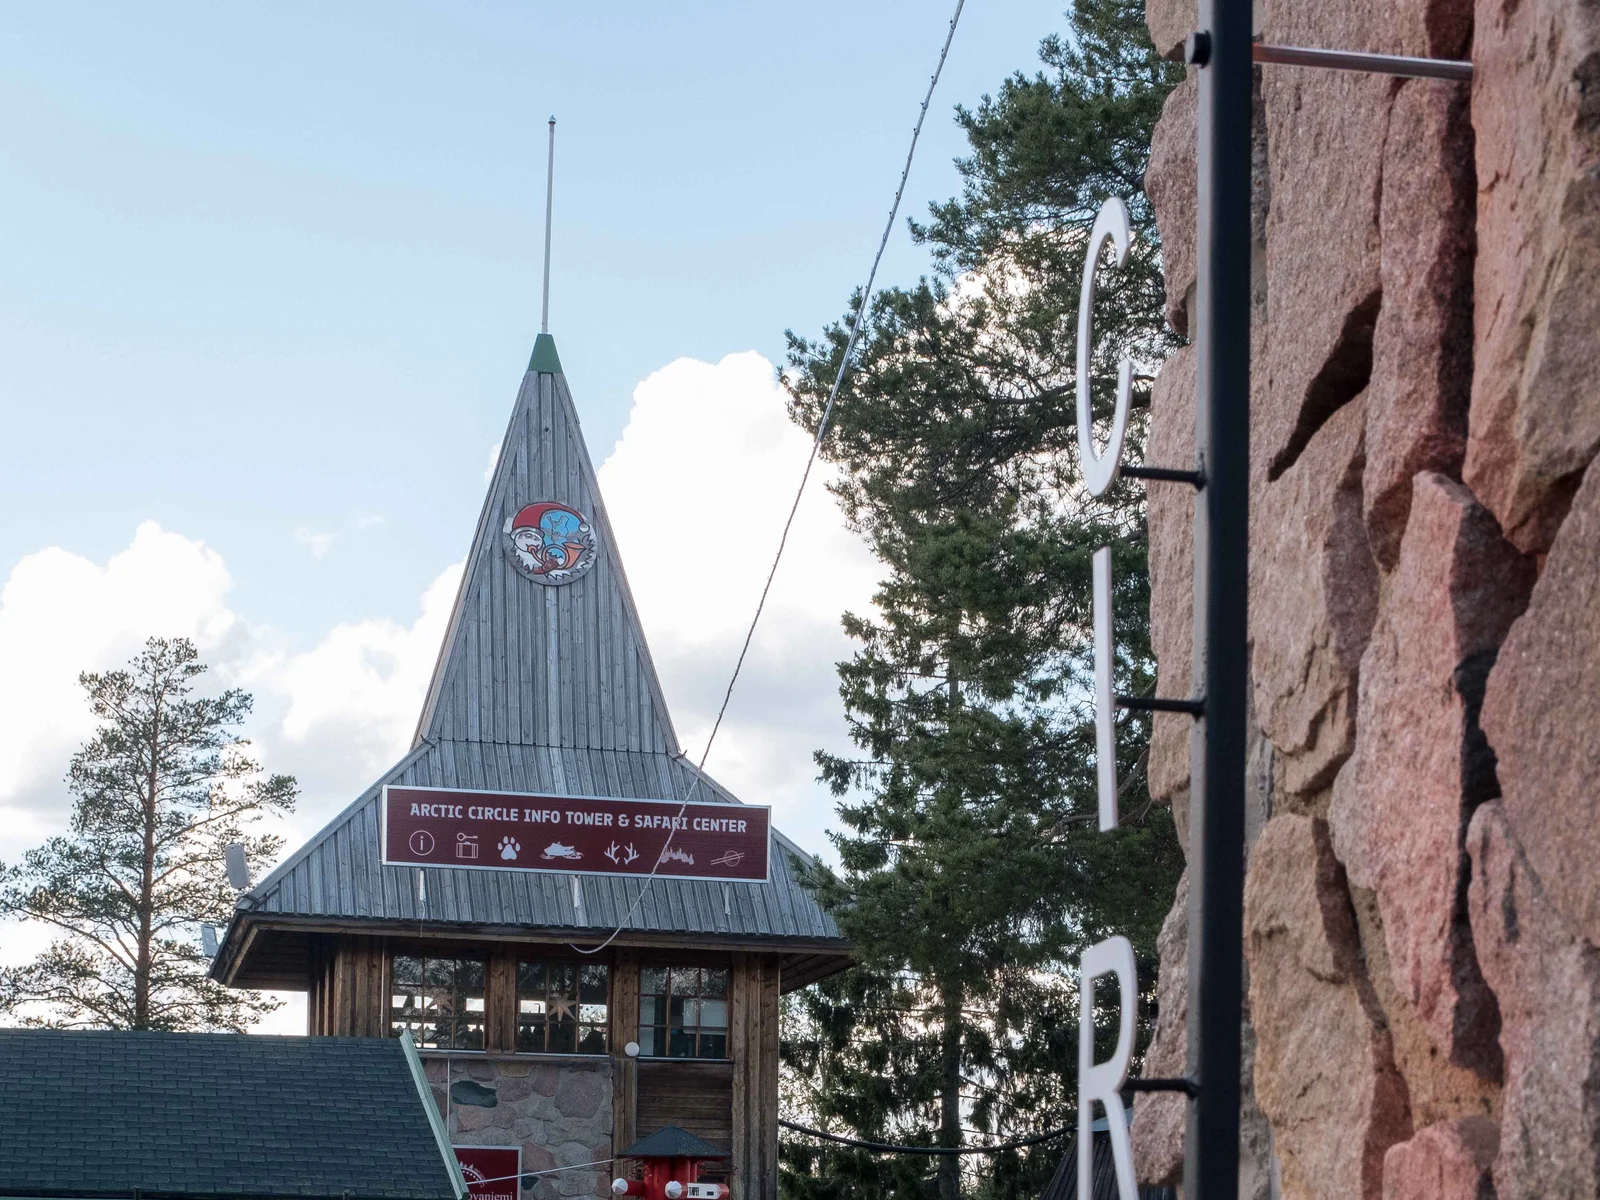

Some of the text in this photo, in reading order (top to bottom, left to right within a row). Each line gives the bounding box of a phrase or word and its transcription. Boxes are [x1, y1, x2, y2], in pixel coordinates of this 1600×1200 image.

[410, 803, 748, 833] ARCTIC CIRCLE INFO TOWER & SAFARI CENTER
